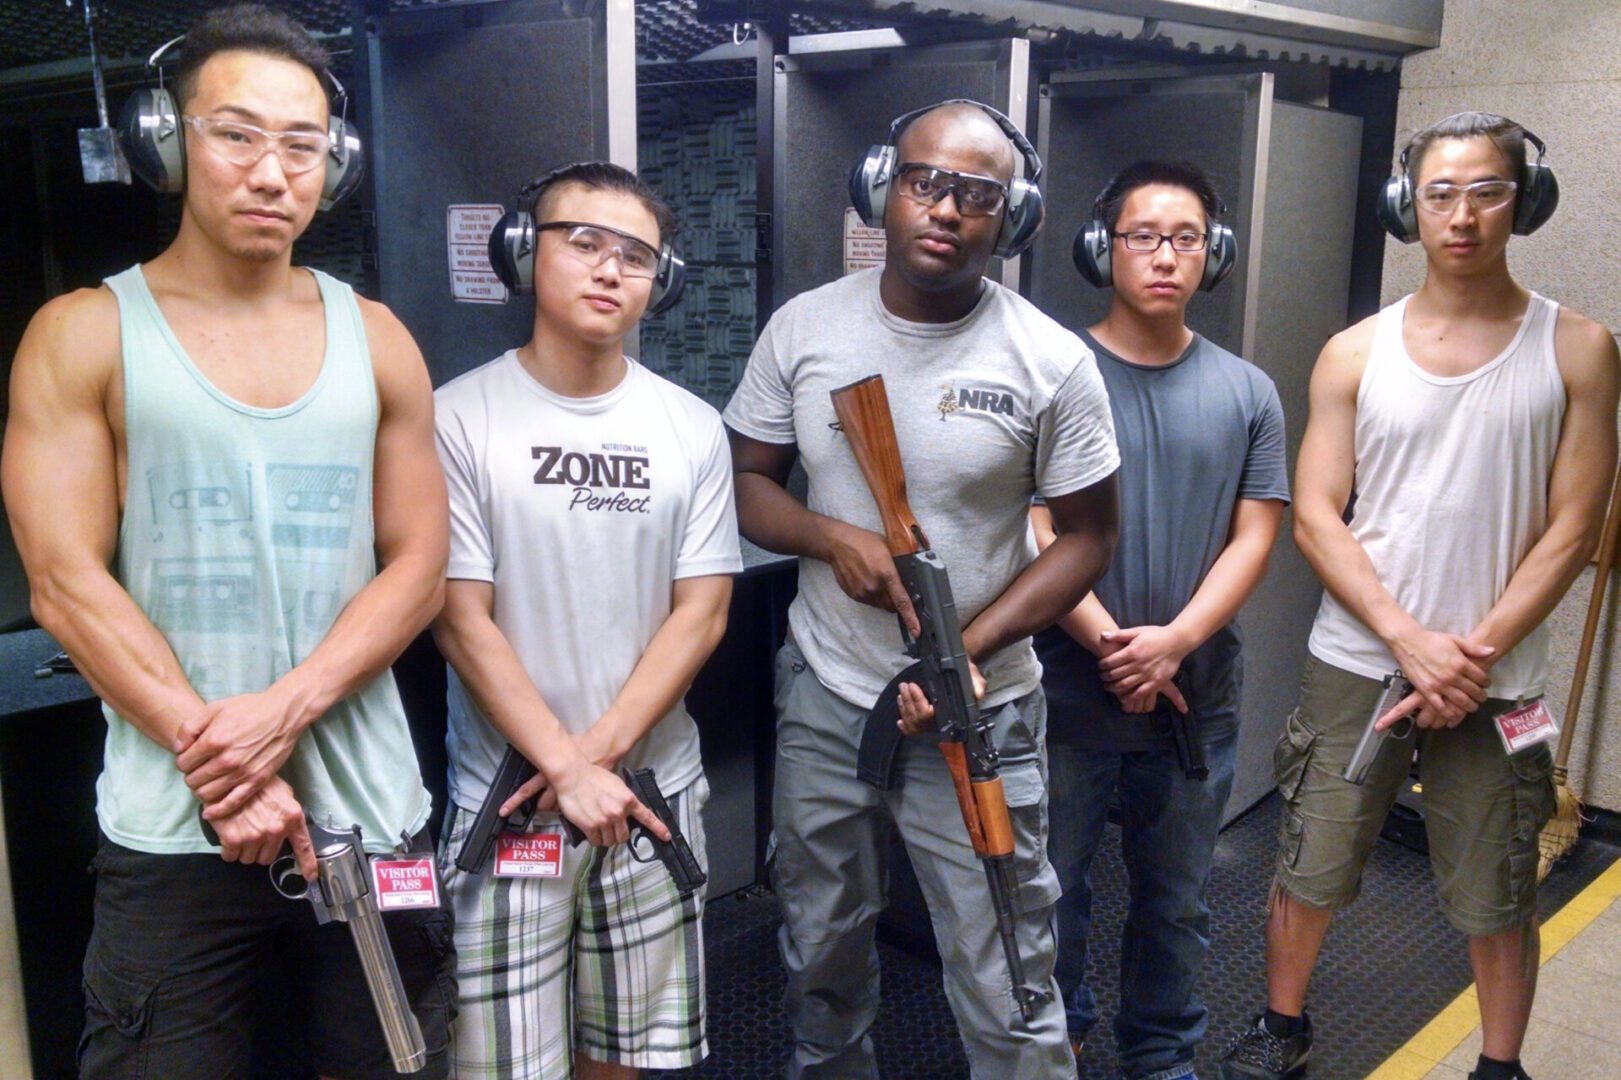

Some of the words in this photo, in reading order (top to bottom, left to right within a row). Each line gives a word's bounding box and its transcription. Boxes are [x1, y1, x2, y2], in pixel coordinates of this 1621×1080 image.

[959, 388, 1014, 417] NRA
[601, 443, 632, 452] NUTRITION
[633, 445, 648, 453] BARS
[531, 446, 651, 490] ZONE
[569, 487, 651, 514] Perfect
[1502, 706, 1544, 729] VISITOR
[1514, 718, 1541, 734] PASS
[502, 839, 557, 850] VISITOR
[512, 850, 546, 860] PASS
[379, 866, 430, 880] VISITOR
[391, 879, 422, 891] PASS
